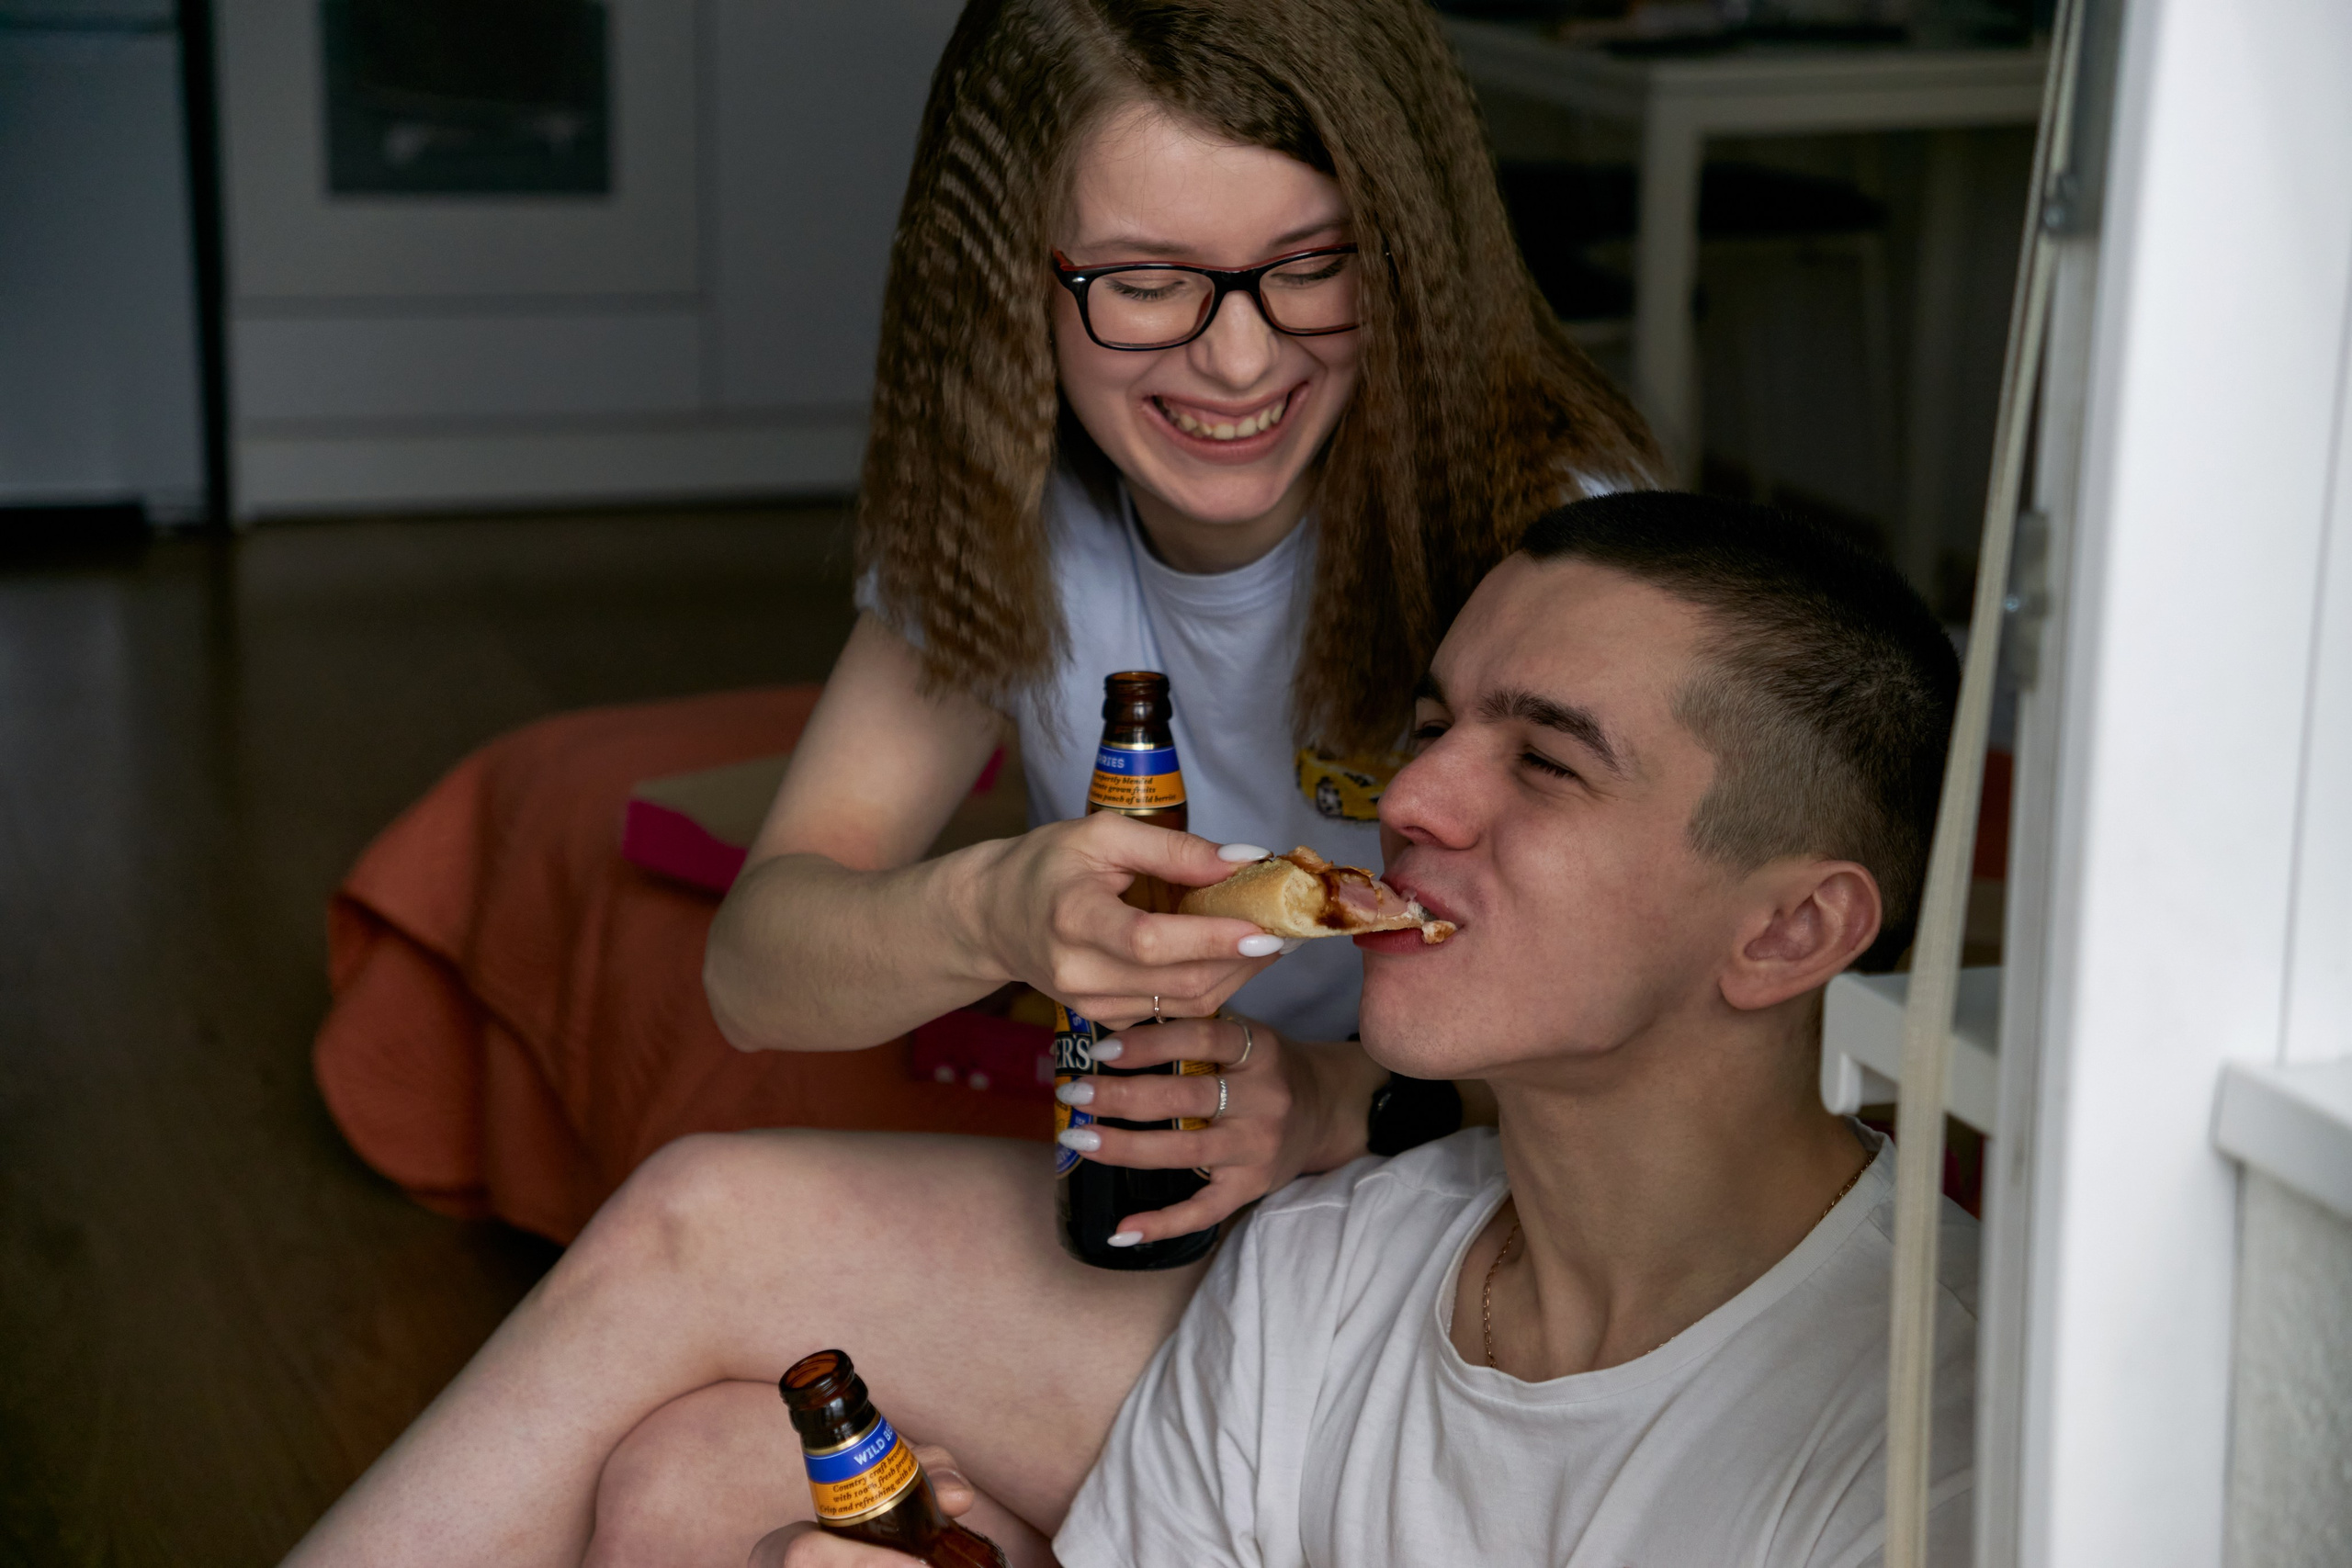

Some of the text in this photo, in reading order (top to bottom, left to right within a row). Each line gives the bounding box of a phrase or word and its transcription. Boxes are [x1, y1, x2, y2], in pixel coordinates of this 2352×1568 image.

[1102, 794, 1125, 802] punch
[1125, 796, 1135, 805] of
[1108, 785, 1131, 794] grown
[854, 1438, 885, 1465] WILD
[832, 1475, 867, 1493] Country
[869, 1461, 888, 1479] craft
[833, 1492, 853, 1504] with
[854, 1482, 876, 1497] 100%
[876, 1468, 896, 1490] fresh
[820, 1505, 837, 1516] Crisp
[838, 1502, 854, 1514] and
[854, 1483, 897, 1509] refreshing
[895, 1469, 910, 1486] with
